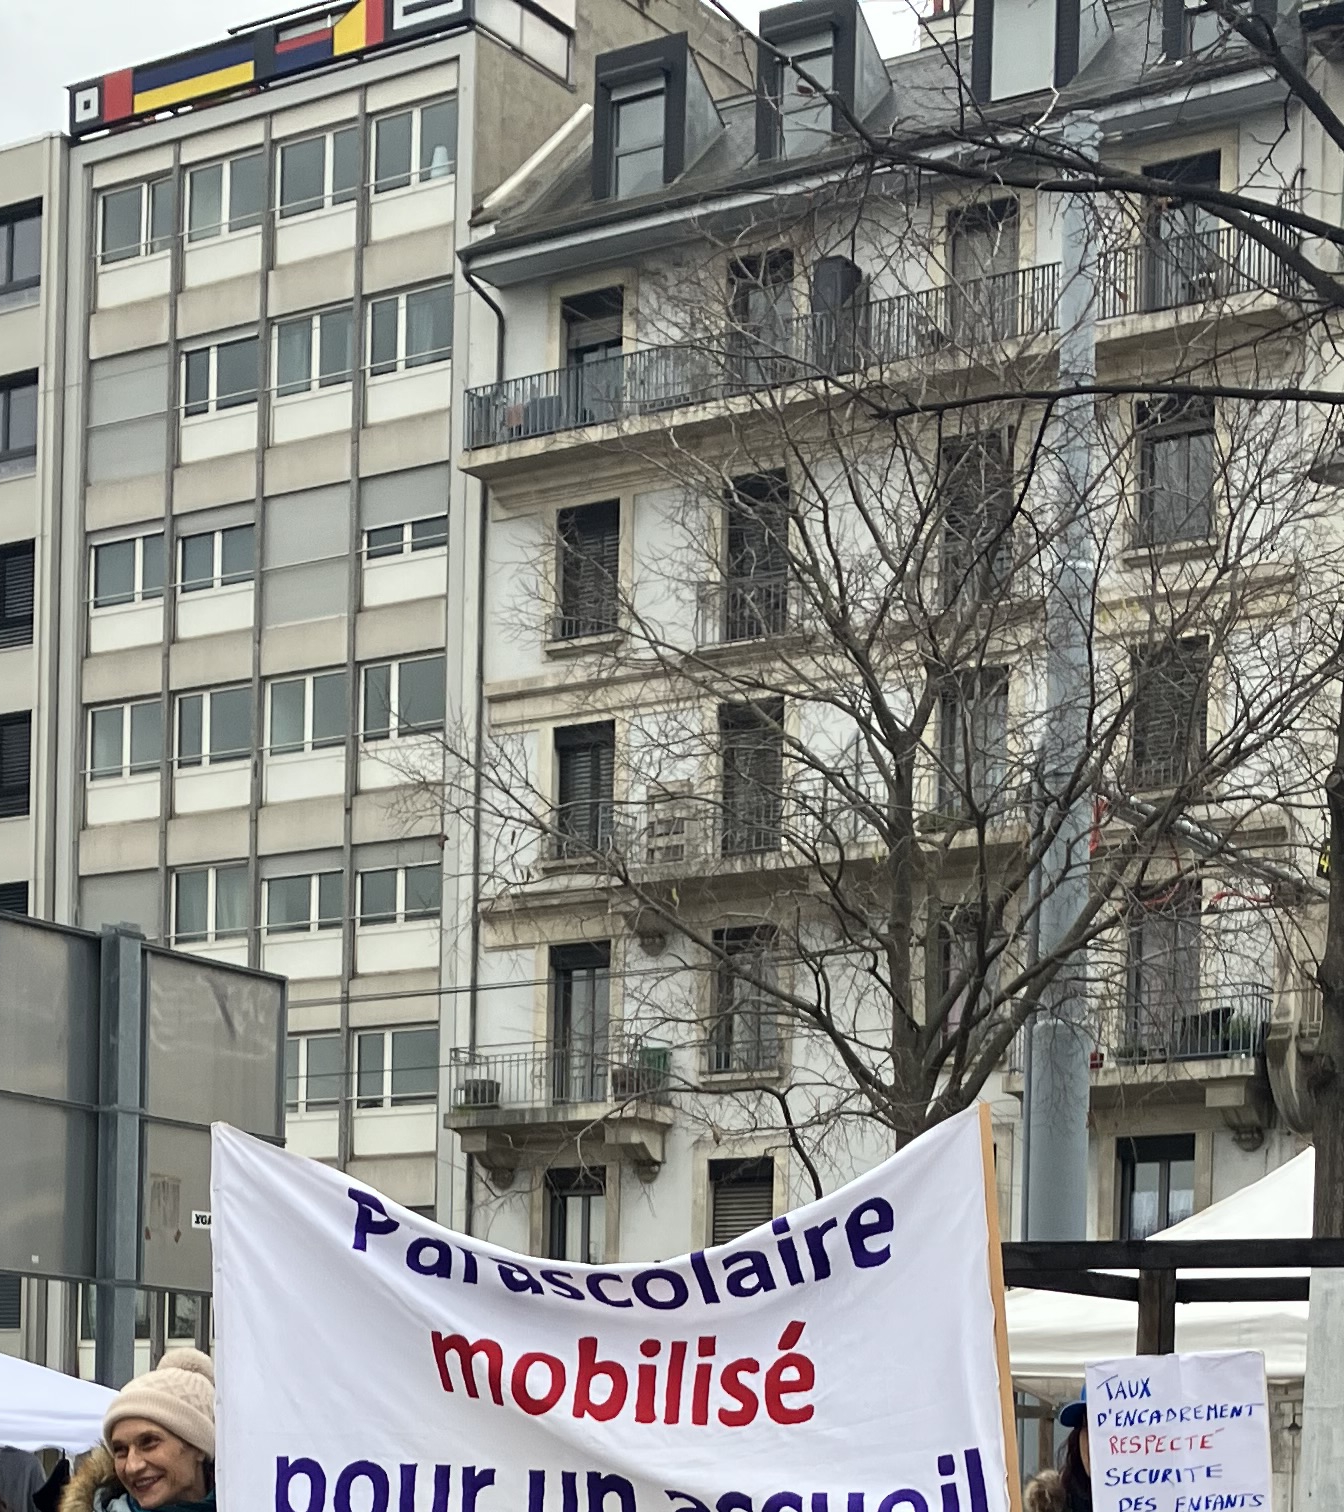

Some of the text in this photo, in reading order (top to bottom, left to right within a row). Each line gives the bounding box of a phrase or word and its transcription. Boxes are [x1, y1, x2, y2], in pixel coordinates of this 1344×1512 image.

[347, 1187, 895, 1310] Parascolaire
[430, 1320, 816, 1428] mobilisé
[1096, 1374, 1152, 1401] TAUX
[1097, 1402, 1264, 1428] D'ENCADREMENT
